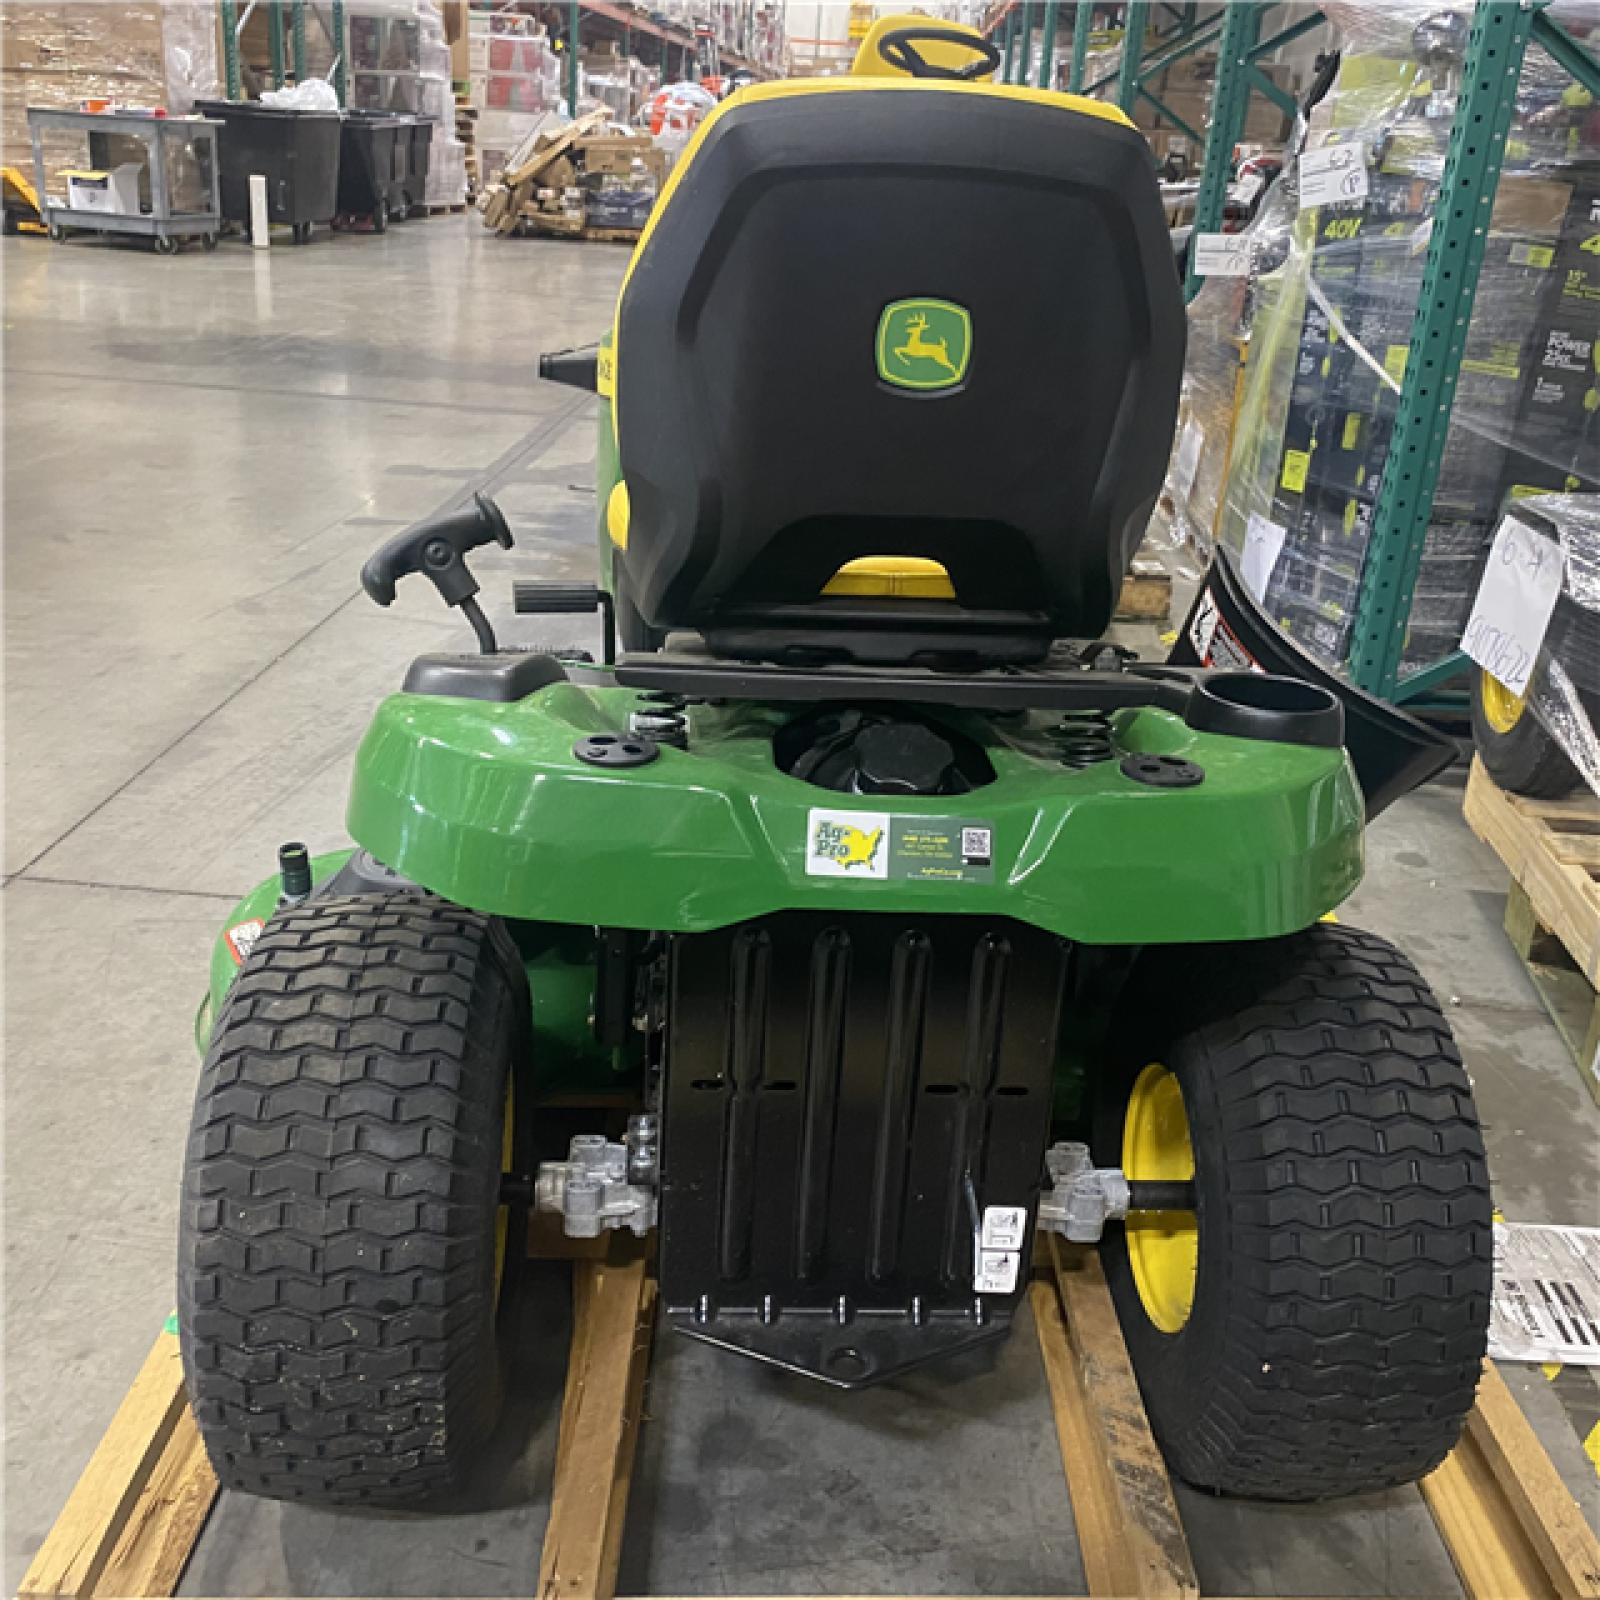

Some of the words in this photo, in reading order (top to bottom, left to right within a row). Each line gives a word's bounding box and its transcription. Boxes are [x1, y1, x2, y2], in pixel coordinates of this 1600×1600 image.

[1324, 218, 1361, 239] 40V
[816, 820, 850, 842] Ag-
[815, 838, 850, 856] Pro
